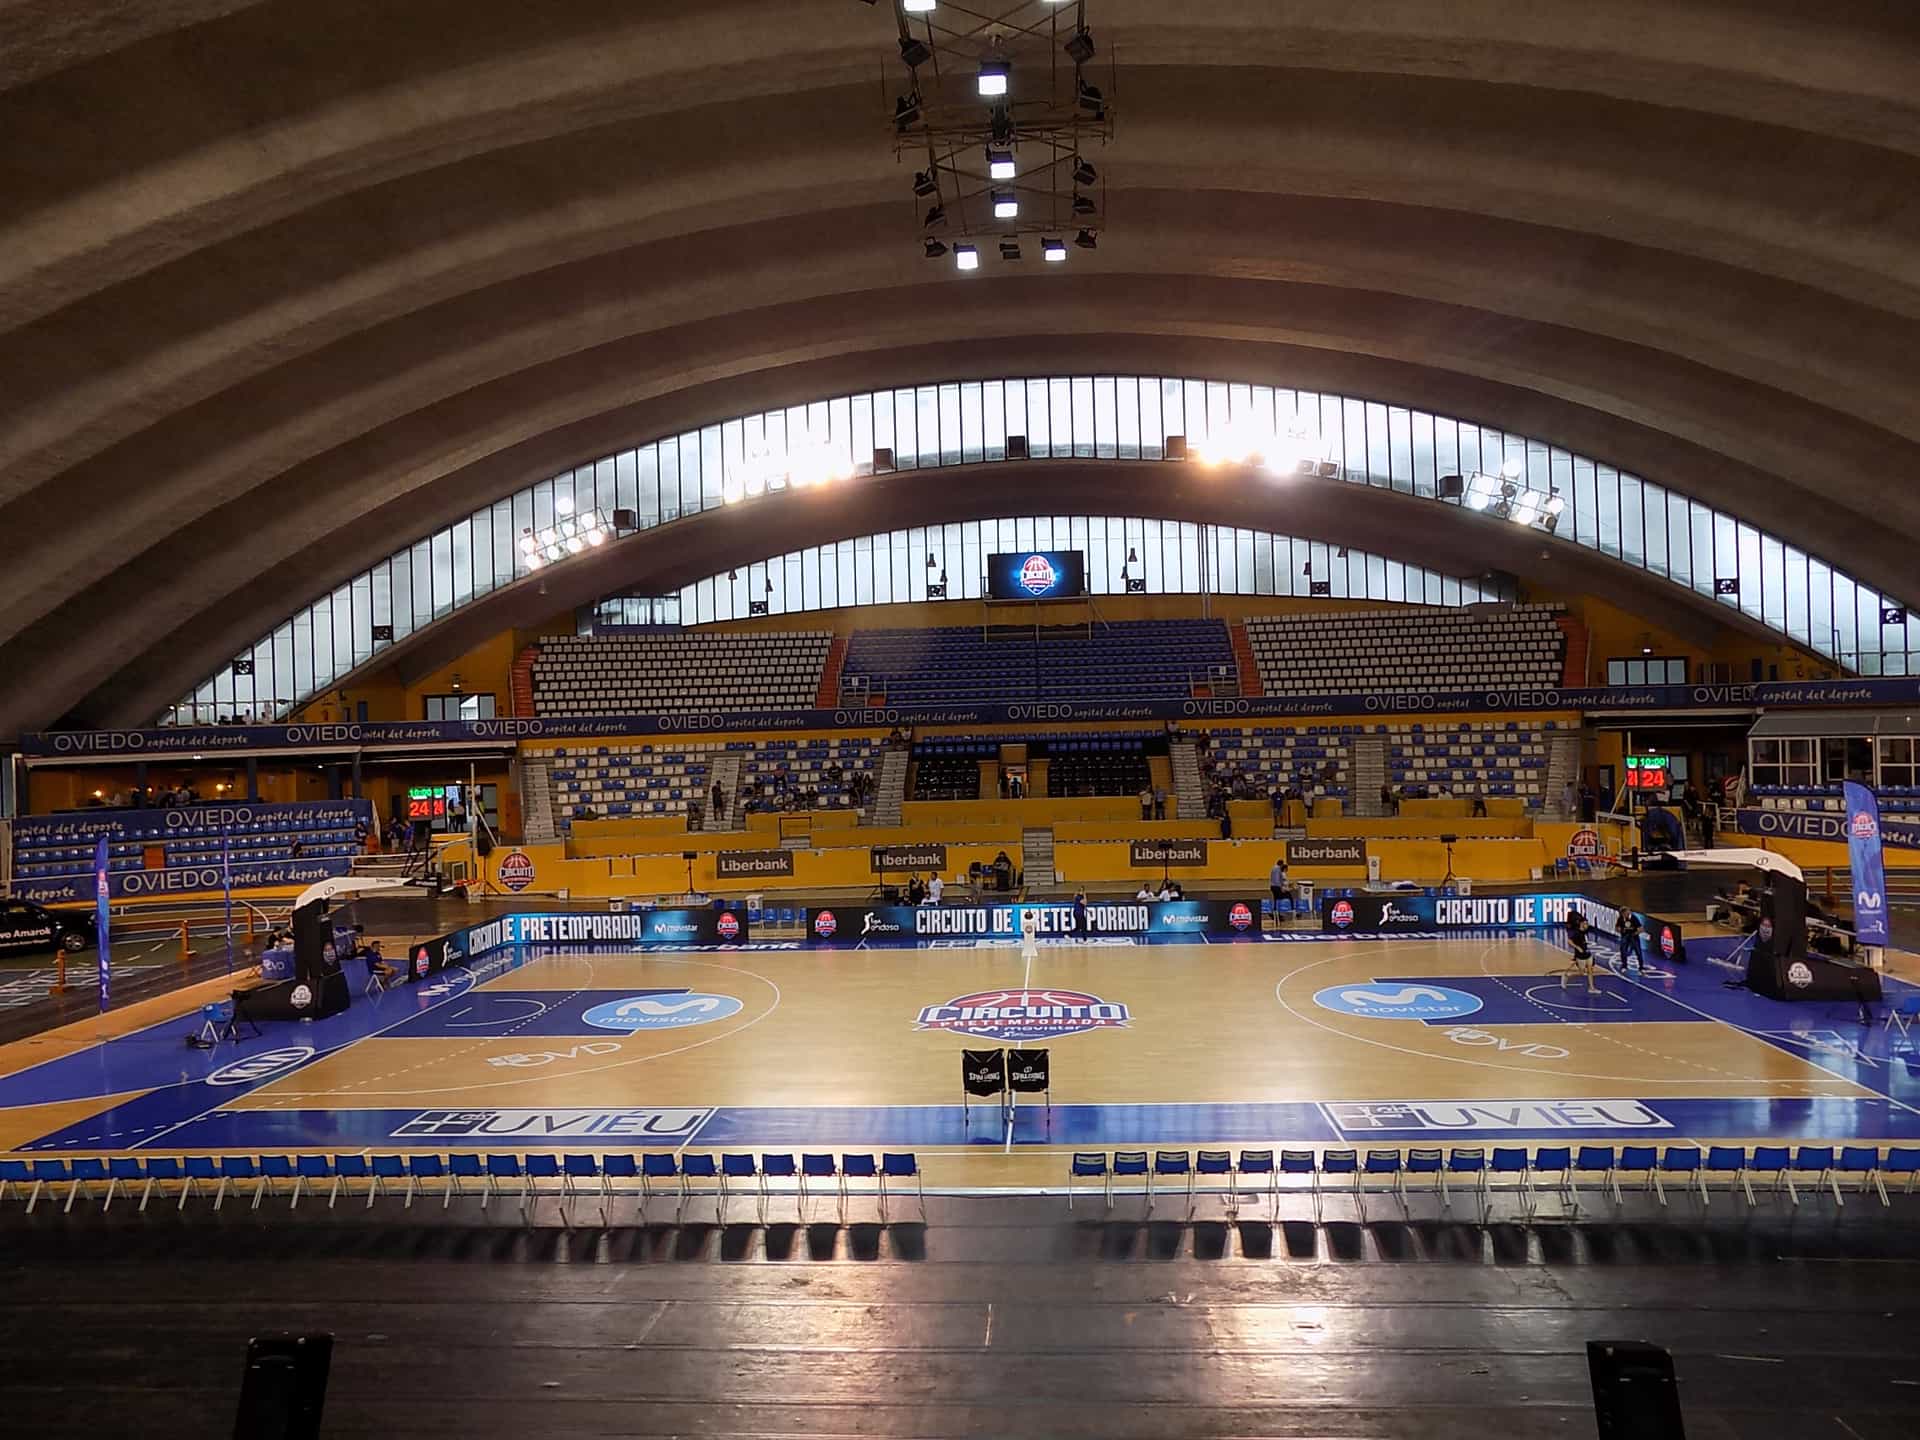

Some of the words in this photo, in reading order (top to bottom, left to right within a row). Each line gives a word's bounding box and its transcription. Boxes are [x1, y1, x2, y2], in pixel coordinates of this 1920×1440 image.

[1365, 695, 1434, 710] OVIEDO
[1486, 691, 1559, 707] OVIEDO
[1617, 693, 1655, 705] deporte
[1762, 689, 1802, 702] capital
[1806, 689, 1825, 700] del
[1828, 688, 1873, 701] deporte
[1007, 704, 1072, 719] OVIEDO
[1122, 705, 1152, 717] deporte
[1183, 700, 1249, 715] OVIEDO
[1301, 702, 1333, 713] deporte
[658, 714, 724, 730] OVIEDO
[774, 716, 804, 728] deporte
[834, 709, 898, 725] OVIEDO
[947, 711, 978, 722] deporte
[406, 727, 441, 739] deporte
[473, 719, 543, 736] OVIEDO
[595, 721, 627, 733] deporte
[54, 732, 144, 750] OVIEDO
[209, 734, 248, 746] deporte
[1642, 770, 1664, 787] 24
[410, 801, 430, 816] 24
[166, 808, 251, 828] OVIEDO
[316, 808, 353, 821] deporte
[56, 823, 75, 834] del
[79, 821, 123, 834] deporte
[1135, 847, 1201, 861] Liberbank
[1291, 846, 1360, 860] Liberbank
[721, 857, 788, 872] Liberbank
[123, 870, 219, 892] OVIEDO
[266, 870, 284, 881] del
[288, 867, 329, 881] deporte
[25, 886, 76, 901] deporte
[1436, 899, 1508, 924] CIRCUITO
[1515, 898, 1536, 923] DE
[521, 915, 642, 941] PRETEMPORADA
[916, 909, 986, 933] CIRCUITO
[993, 908, 1013, 933] DE
[13, 927, 51, 938] Amarok
[925, 1003, 1124, 1021] CIRCUITO
[1353, 1004, 1461, 1014] movistar
[600, 1014, 702, 1024] movistar
[939, 1018, 1107, 1028] PRETEMPORADA
[1003, 1024, 1081, 1032] movistar
[478, 1110, 699, 1134] UVIÉU
[1416, 1102, 1661, 1128] UVIÉU
